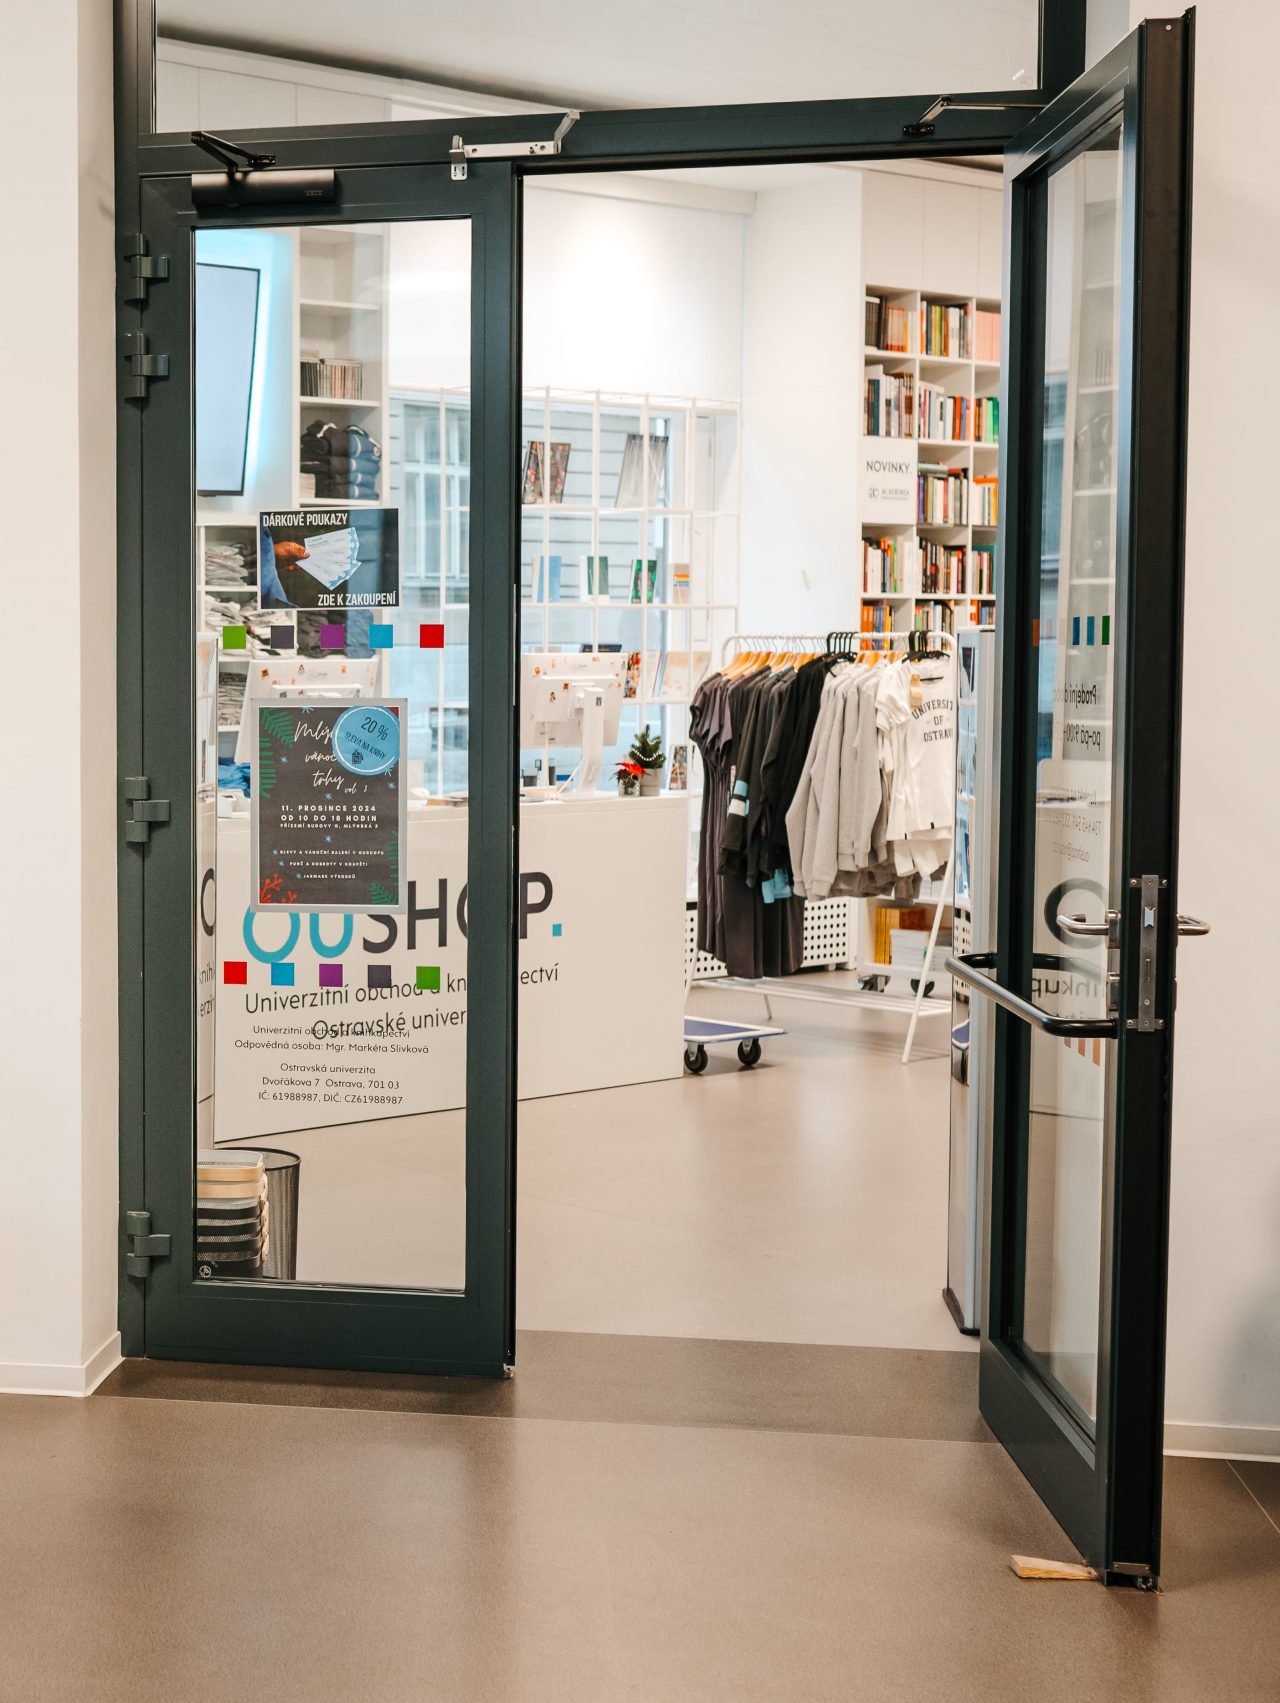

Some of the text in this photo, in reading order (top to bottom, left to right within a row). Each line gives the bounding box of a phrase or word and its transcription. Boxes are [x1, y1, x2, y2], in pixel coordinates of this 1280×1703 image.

[262, 512, 348, 527] DÁRKOVÉ POUKAZY
[317, 590, 396, 606] ZDE K ZAKOUPENÍ
[933, 715, 944, 726] OF
[361, 716, 389, 741] 20 %
[345, 731, 362, 746] SLEVA
[361, 741, 371, 751] NA
[312, 768, 345, 790] trhy
[346, 815, 377, 823] HODIN
[245, 984, 349, 1014] Univerzitní
[412, 1008, 467, 1030] univer
[253, 1026, 302, 1035] Univerzitní
[234, 1039, 429, 1054] Odpovědná osoba: Mgr. Markéta Slivková
[280, 1063, 376, 1075] Ostravská univerzita
[262, 1076, 312, 1087] Dvořákova
[314, 1078, 320, 1087] 7
[368, 1080, 384, 1089] 701
[387, 1081, 400, 1090] 03
[258, 1089, 270, 1101] IČ:
[323, 1092, 342, 1103] DIČ:
[344, 1094, 403, 1105] CZ61988987
